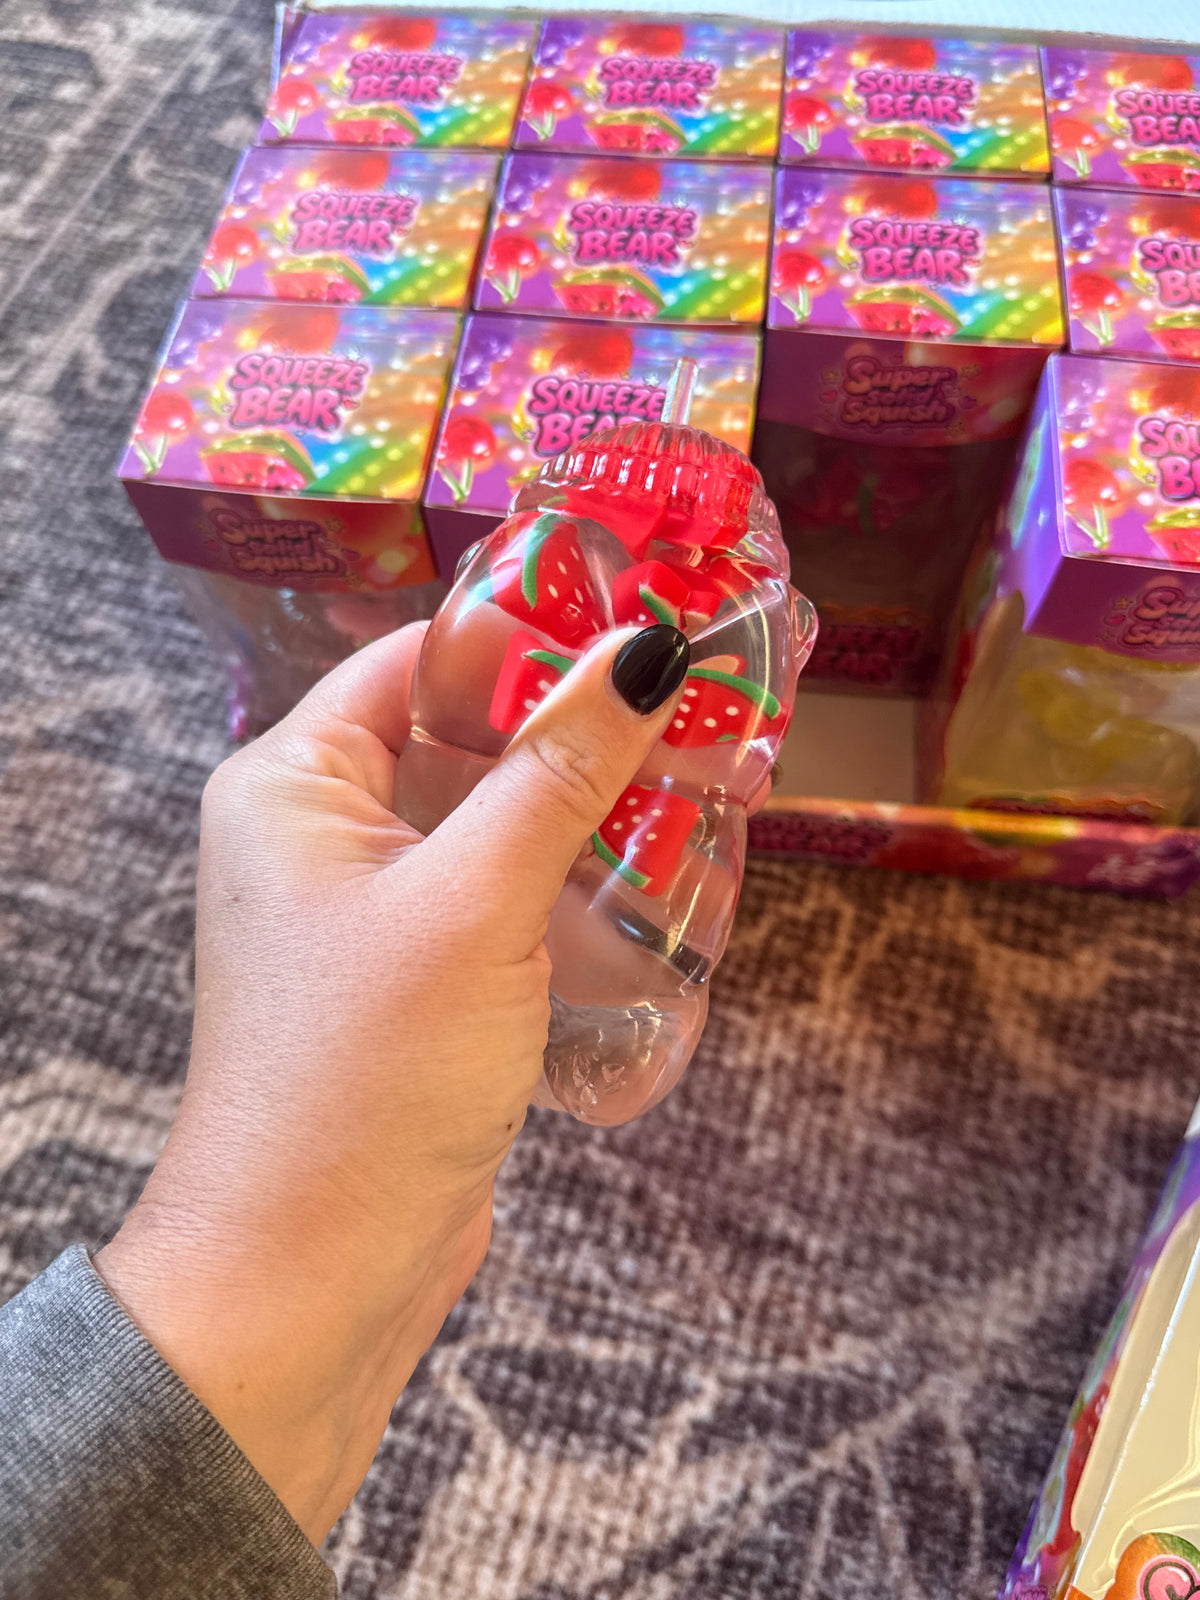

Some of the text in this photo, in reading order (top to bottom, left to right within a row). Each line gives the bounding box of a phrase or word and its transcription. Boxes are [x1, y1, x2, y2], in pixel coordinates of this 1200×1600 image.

[346, 52, 463, 79] SQUEEZE
[599, 58, 716, 86] SQUEEZE
[349, 75, 442, 104] BEAR
[604, 81, 702, 110] BEAR
[854, 71, 974, 100] SQUEEZE
[866, 94, 965, 125] BEAR
[1131, 115, 1200, 146] BEA
[291, 193, 417, 224] SQUEEZE
[568, 202, 697, 237] SQUEEZE
[291, 219, 394, 253] BEAR
[575, 230, 679, 266] BEAR
[849, 219, 979, 255] SQUEEZE
[862, 247, 969, 286] BEAR
[230, 353, 369, 395] SQUEEZE
[843, 356, 956, 395] Super
[230, 386, 341, 432] BEAR
[527, 376, 667, 420] SQUEEZE
[212, 510, 321, 544] Super
